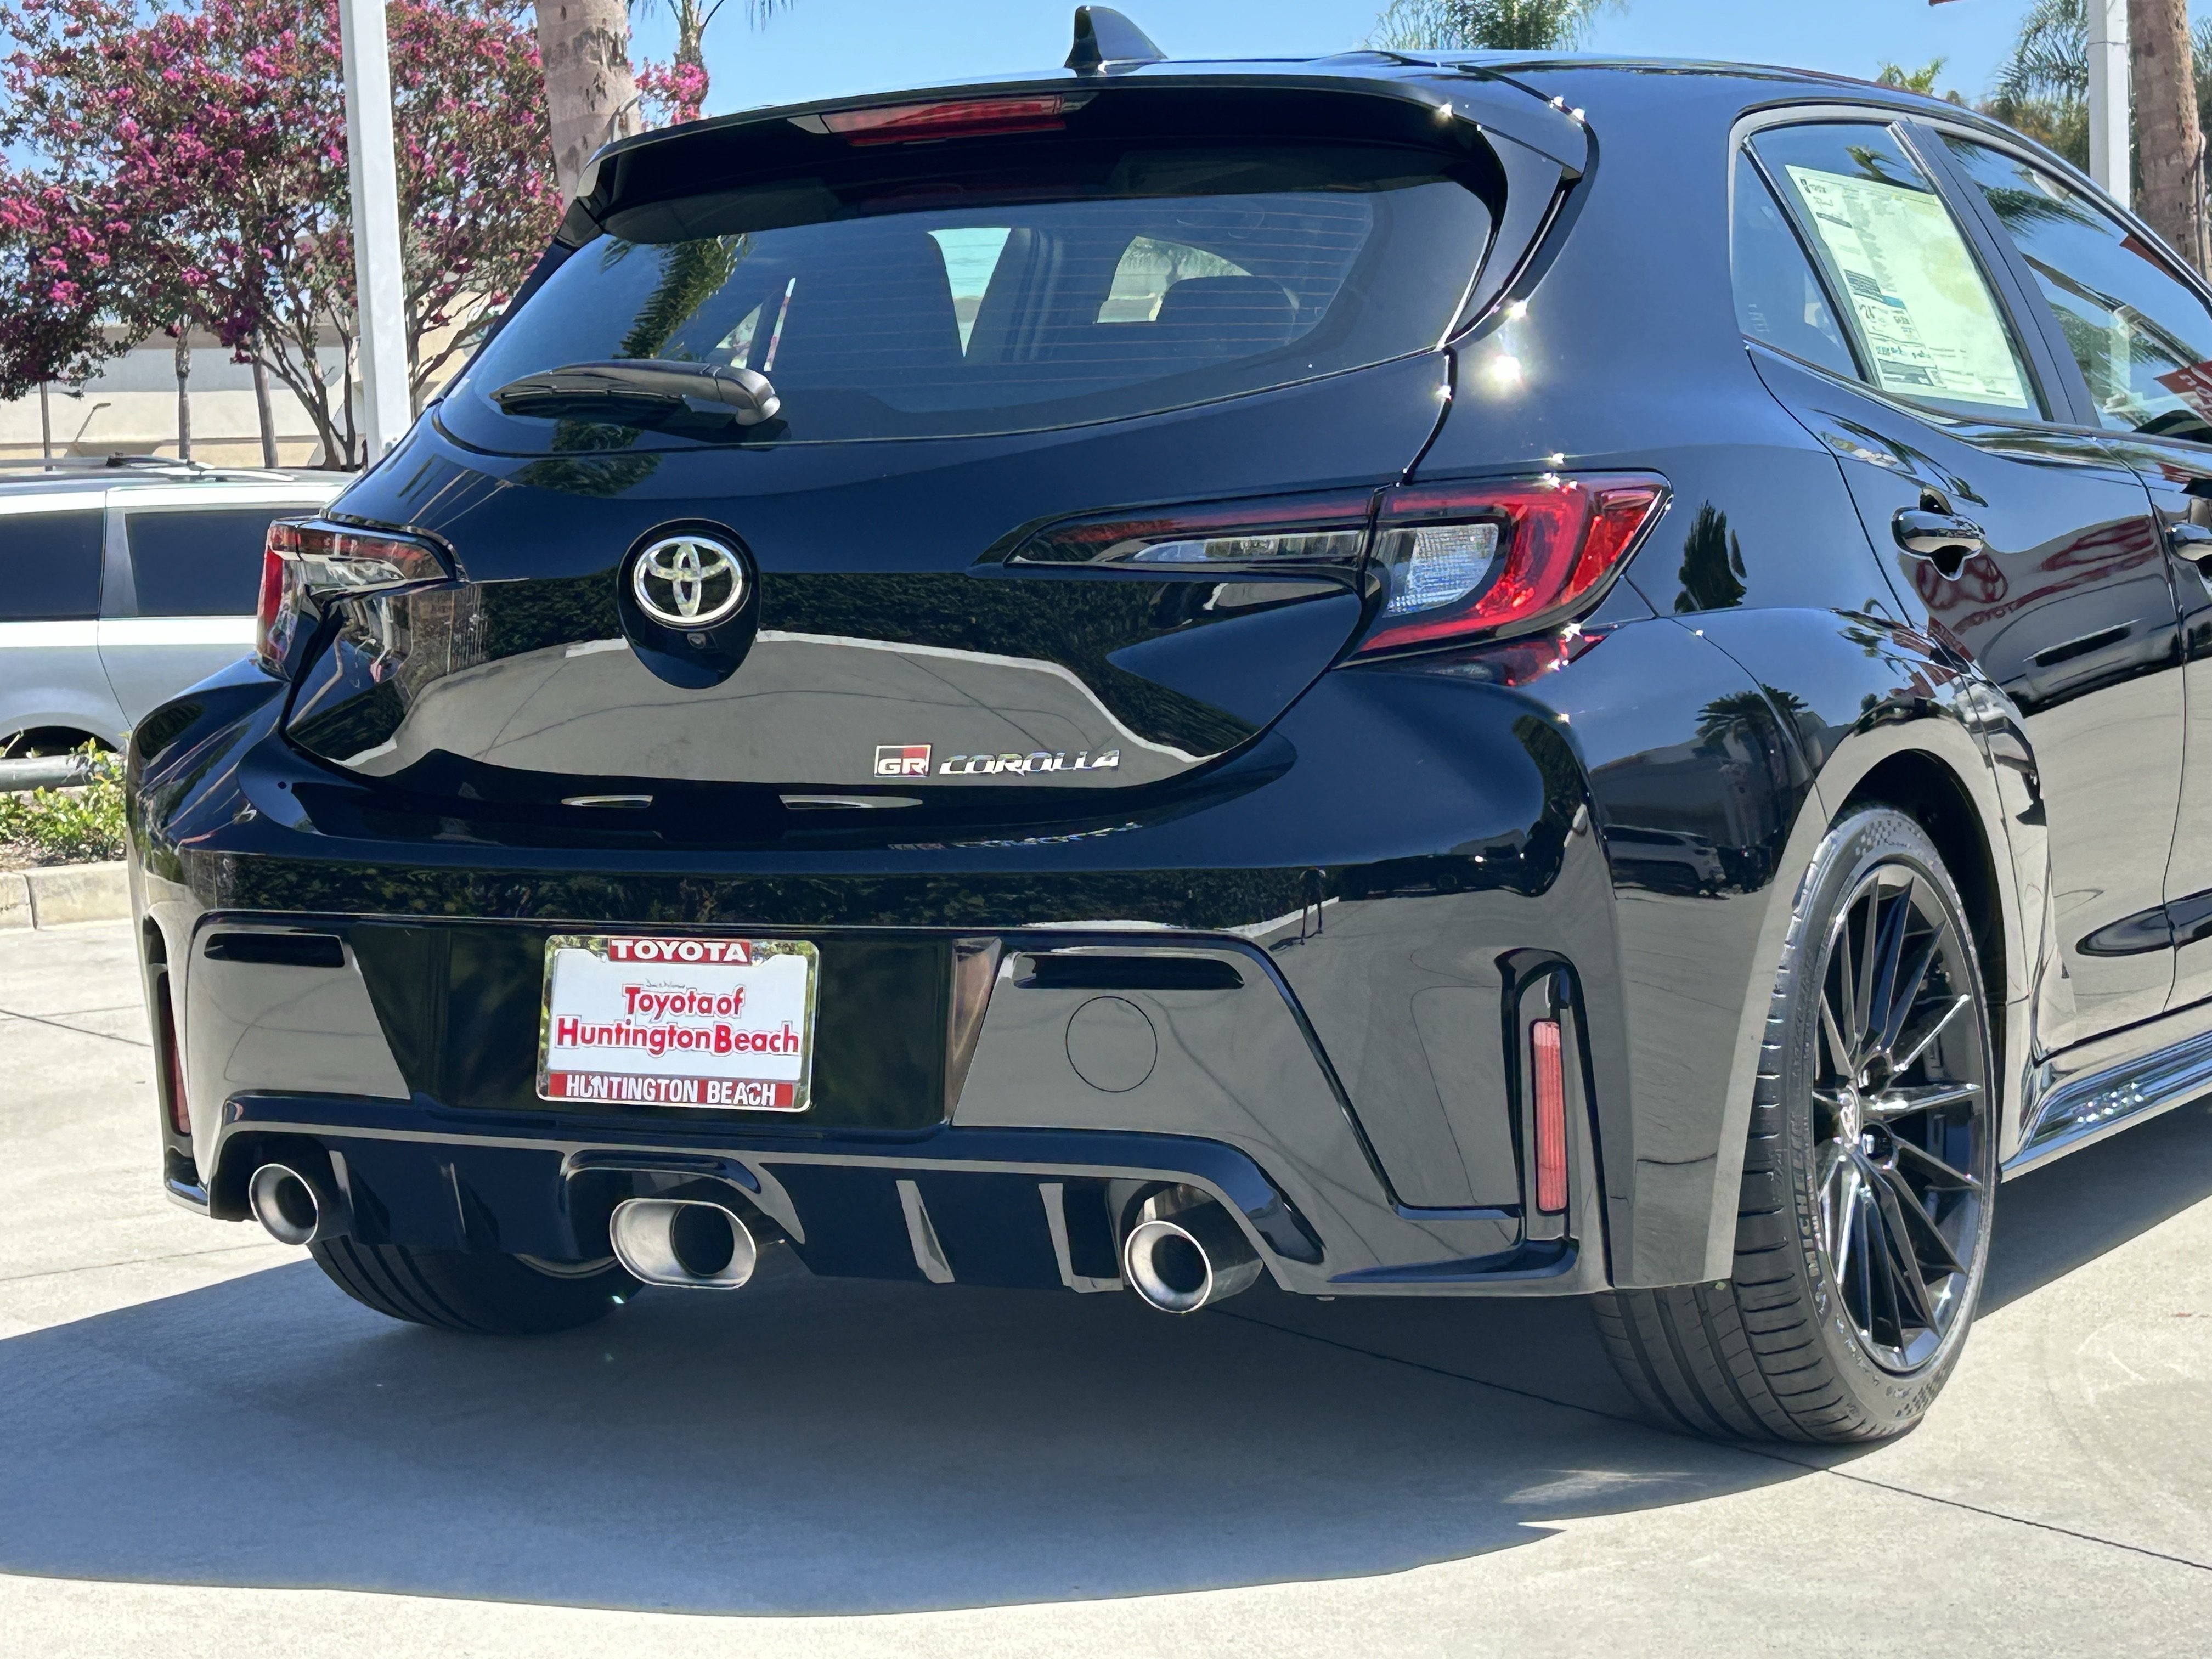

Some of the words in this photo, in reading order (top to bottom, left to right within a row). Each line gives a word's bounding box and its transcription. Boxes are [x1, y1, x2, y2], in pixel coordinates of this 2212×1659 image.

[939, 749, 1120, 776] COROLLA
[612, 940, 748, 962] TOYOTA
[625, 987, 713, 1020] Toyota
[716, 987, 743, 1015] of
[557, 1017, 710, 1055] Huntington
[714, 1024, 798, 1053] Beach
[566, 1075, 698, 1103] HUNTINGTON
[707, 1080, 776, 1107] BEACH
